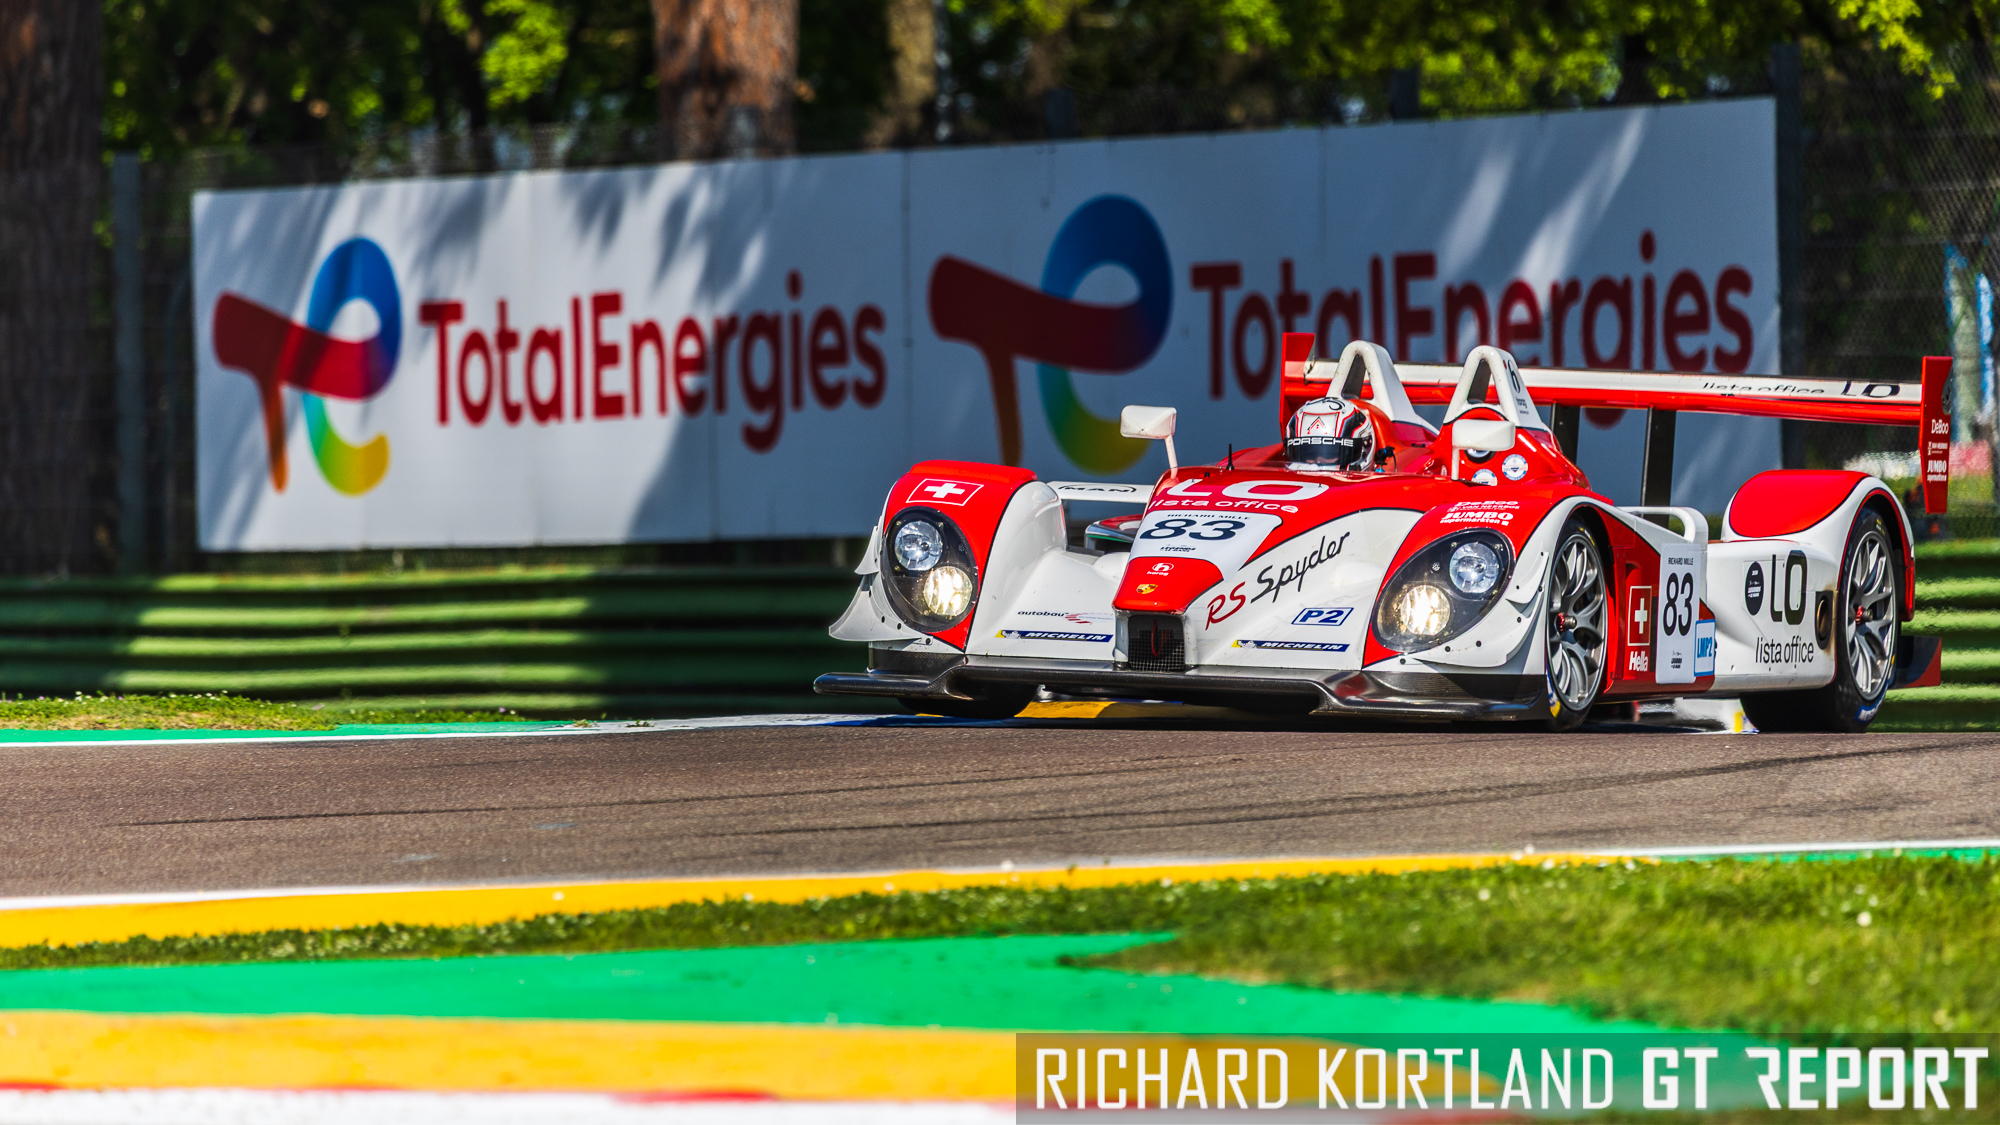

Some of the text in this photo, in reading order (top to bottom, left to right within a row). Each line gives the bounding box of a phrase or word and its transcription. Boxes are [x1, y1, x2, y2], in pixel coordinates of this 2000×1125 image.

[1190, 228, 1755, 428] TotalEnergies
[418, 268, 888, 455] TotalEnergies
[1703, 380, 1901, 398] lista office LO
[1931, 419, 1949, 434] DeBoo
[1287, 437, 1354, 447] PORSCHE
[1927, 460, 1947, 473] JUMBO
[1167, 479, 1330, 501] LO
[1149, 499, 1299, 513] lista office
[1441, 511, 1514, 520] JUMBO
[1139, 518, 1246, 541] 83
[1205, 531, 1350, 631] RS Spyder
[1770, 550, 1807, 625] LO
[1663, 572, 1694, 636] 83
[1299, 610, 1344, 624] P2
[1025, 631, 1107, 641] MICHELIN
[1261, 642, 1344, 650] MICHELIN
[1697, 637, 1713, 658] LMP2
[1755, 635, 1814, 663] lista office
[1629, 651, 1648, 671] Hella
